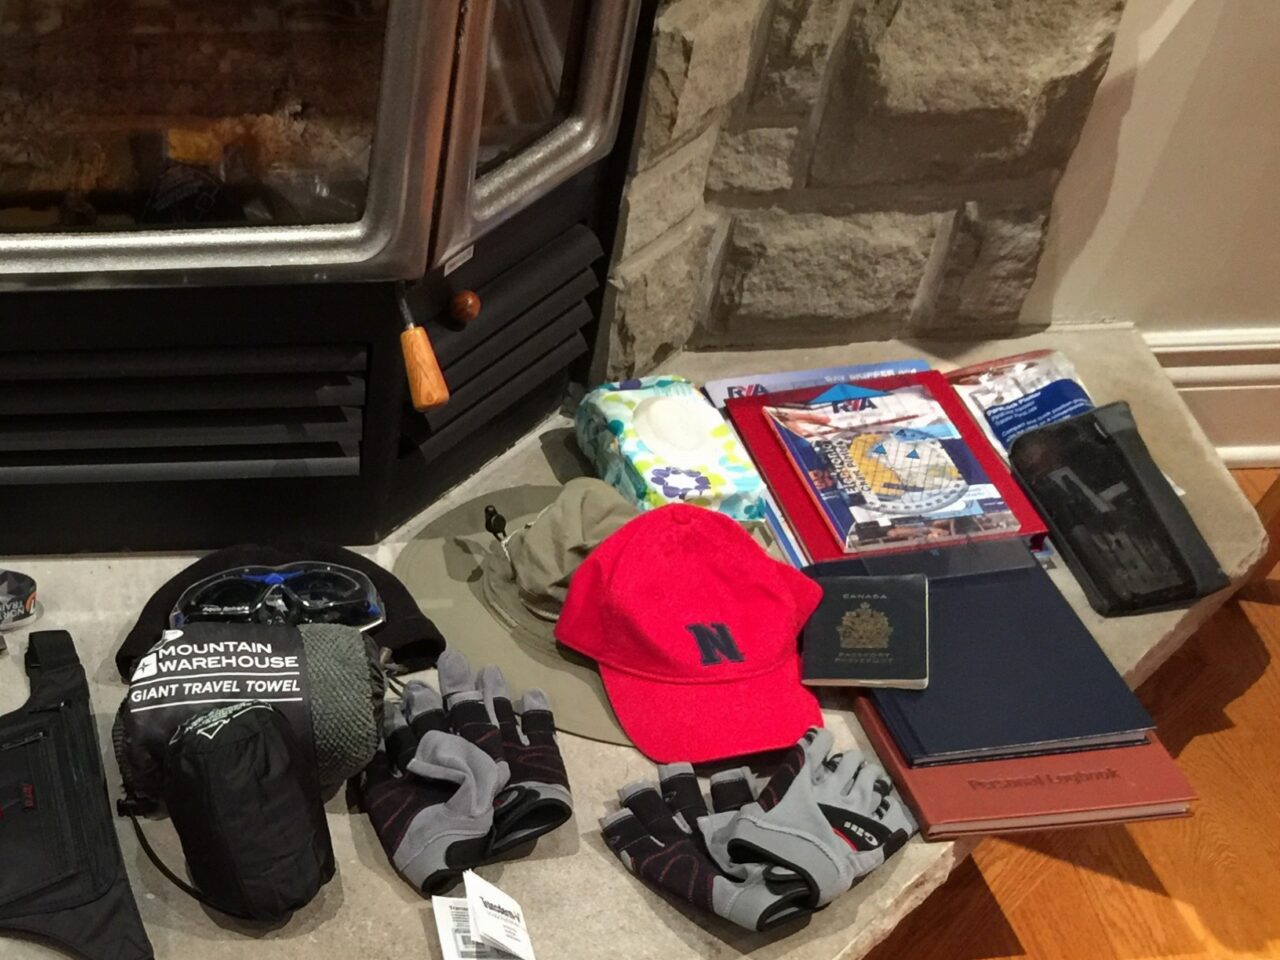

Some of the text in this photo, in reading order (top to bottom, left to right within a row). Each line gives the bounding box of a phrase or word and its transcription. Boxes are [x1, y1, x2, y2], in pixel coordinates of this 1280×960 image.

[158, 641, 272, 659] MOUNTAIN
[684, 621, 745, 666] N
[158, 656, 299, 673] WAREHOUSE
[131, 680, 301, 702] GIANT TRAVEL TOWEL
[968, 774, 1045, 790] Personal
